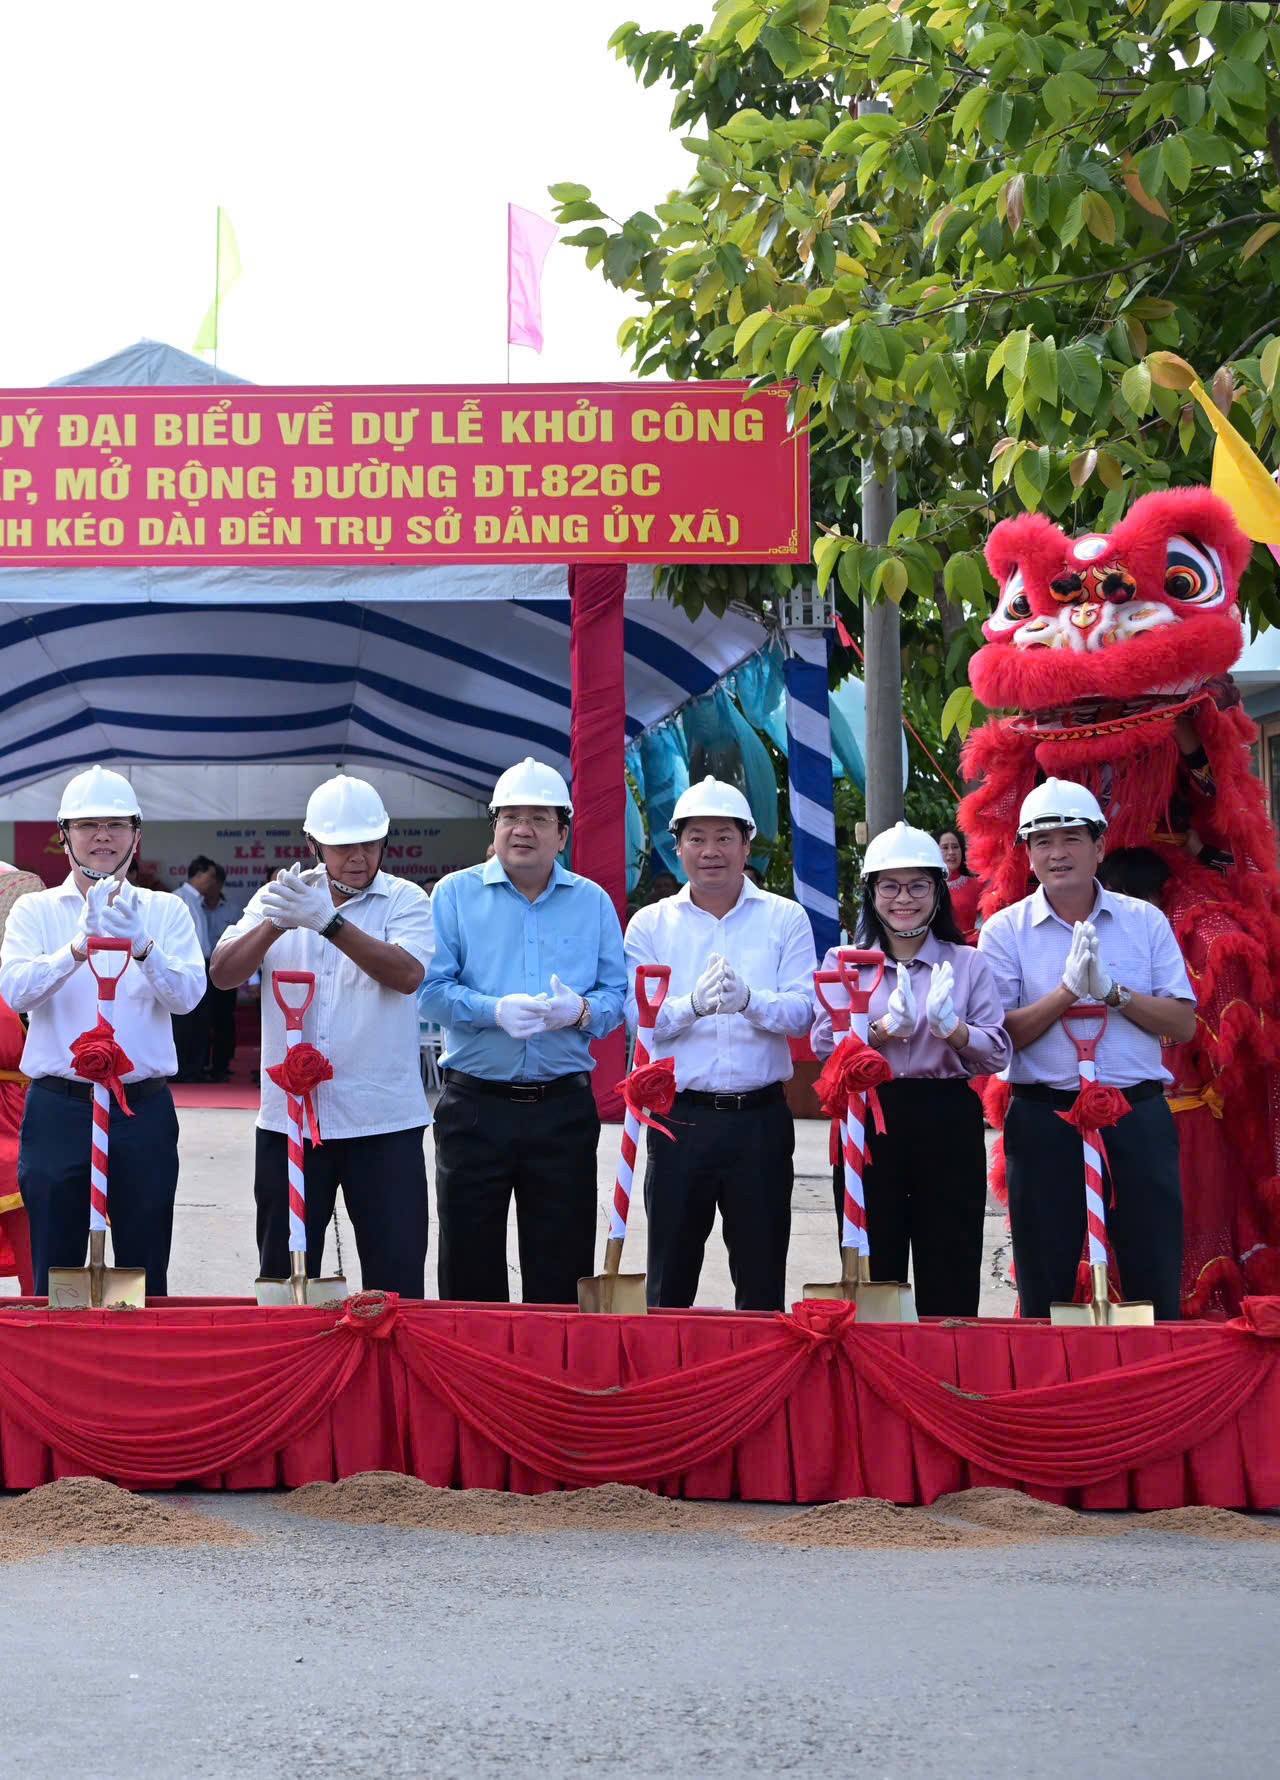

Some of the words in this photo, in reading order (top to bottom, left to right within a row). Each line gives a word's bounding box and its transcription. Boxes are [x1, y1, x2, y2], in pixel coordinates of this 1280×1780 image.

[59, 415, 137, 455] ĐẠI
[155, 399, 261, 446] BIỂU
[278, 401, 334, 445] VỀ
[352, 409, 420, 452] DỰ
[431, 399, 484, 444] LỄ
[502, 399, 613, 444] KHỞI
[631, 402, 763, 442] CÔNG
[56, 457, 132, 501] MỞ
[147, 459, 277, 507] RỘNG
[292, 457, 457, 500] ĐƯỜNG
[474, 463, 661, 498] ĐT.826C
[47, 511, 125, 547] KÉO
[140, 511, 206, 546] DÀI
[220, 510, 302, 546] ĐẾN
[316, 516, 392, 552] TRỤ
[407, 506, 462, 545] SỞ
[474, 505, 589, 545] ĐẢNG
[604, 504, 655, 543] ỦY
[669, 508, 739, 547] XÃ)
